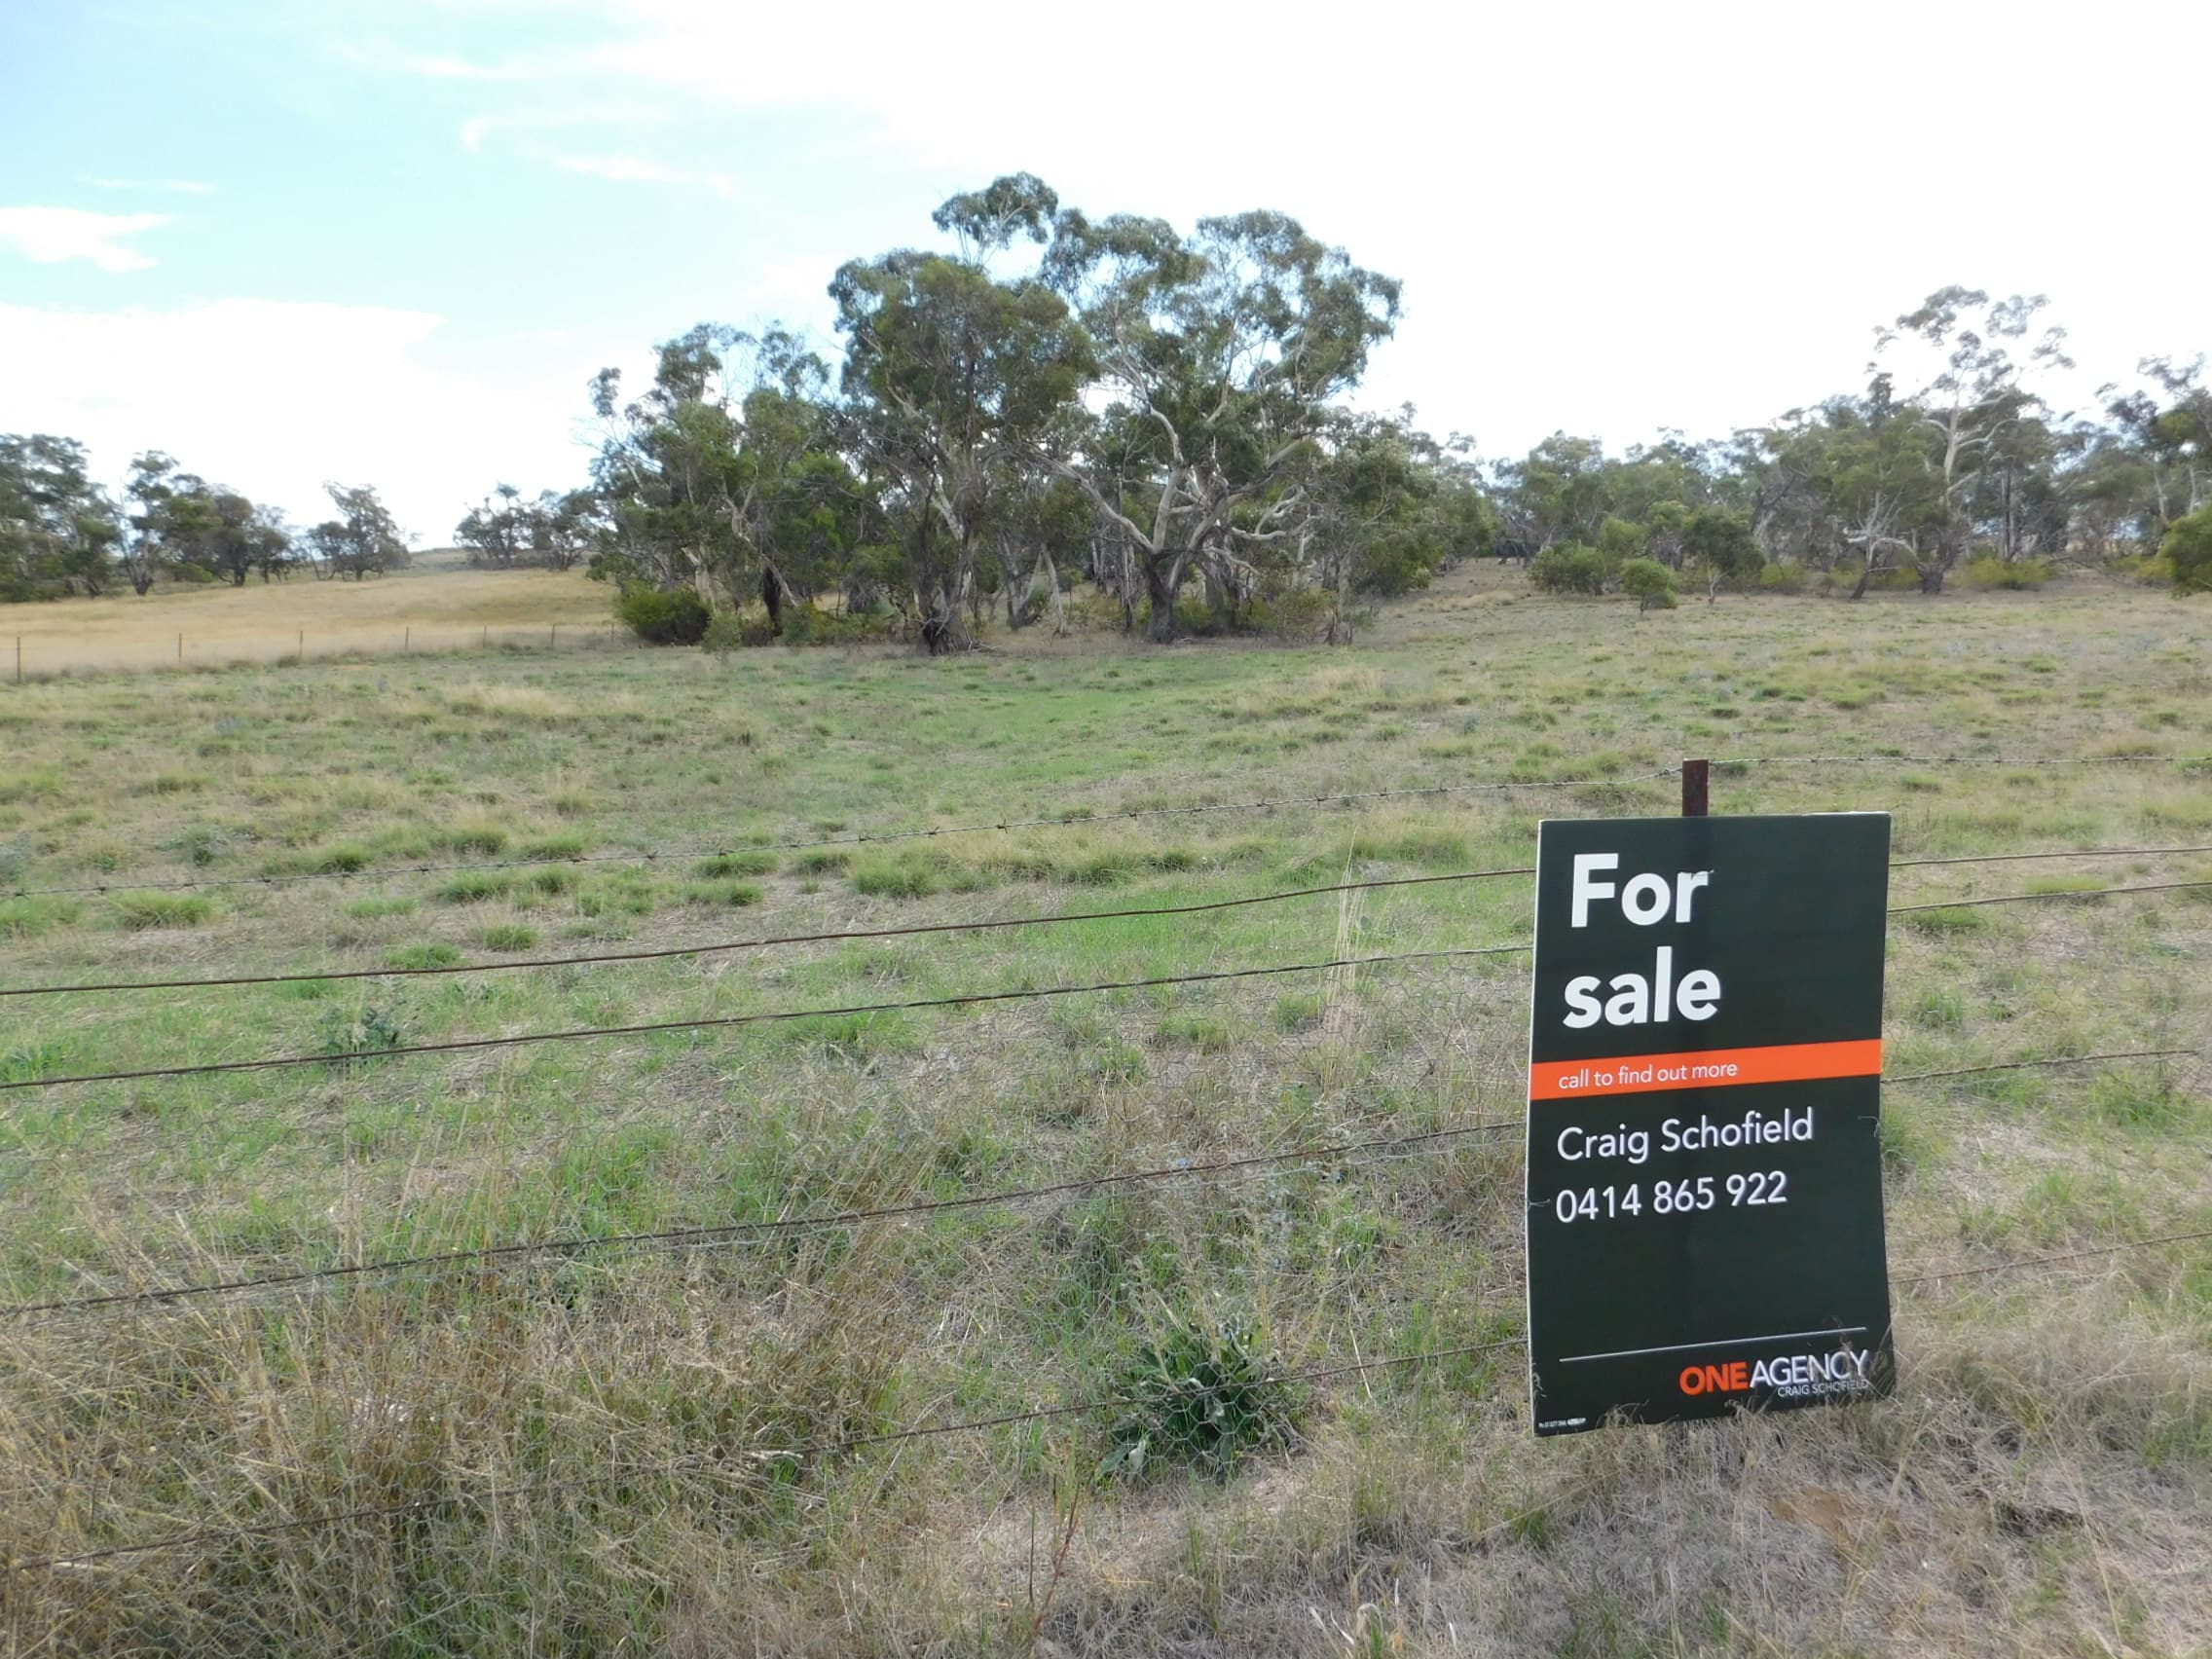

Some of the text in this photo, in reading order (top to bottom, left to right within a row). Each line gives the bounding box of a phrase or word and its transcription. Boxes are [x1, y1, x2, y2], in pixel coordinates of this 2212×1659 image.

[1571, 853, 1712, 927] For
[1563, 945, 1721, 1028] sale
[1559, 1062, 1738, 1089] call to find out more
[1558, 1106, 1814, 1163] Craig Schofield
[1557, 1170, 1788, 1223] 0414 865 922
[1778, 1382, 1810, 1397] CRAIG
